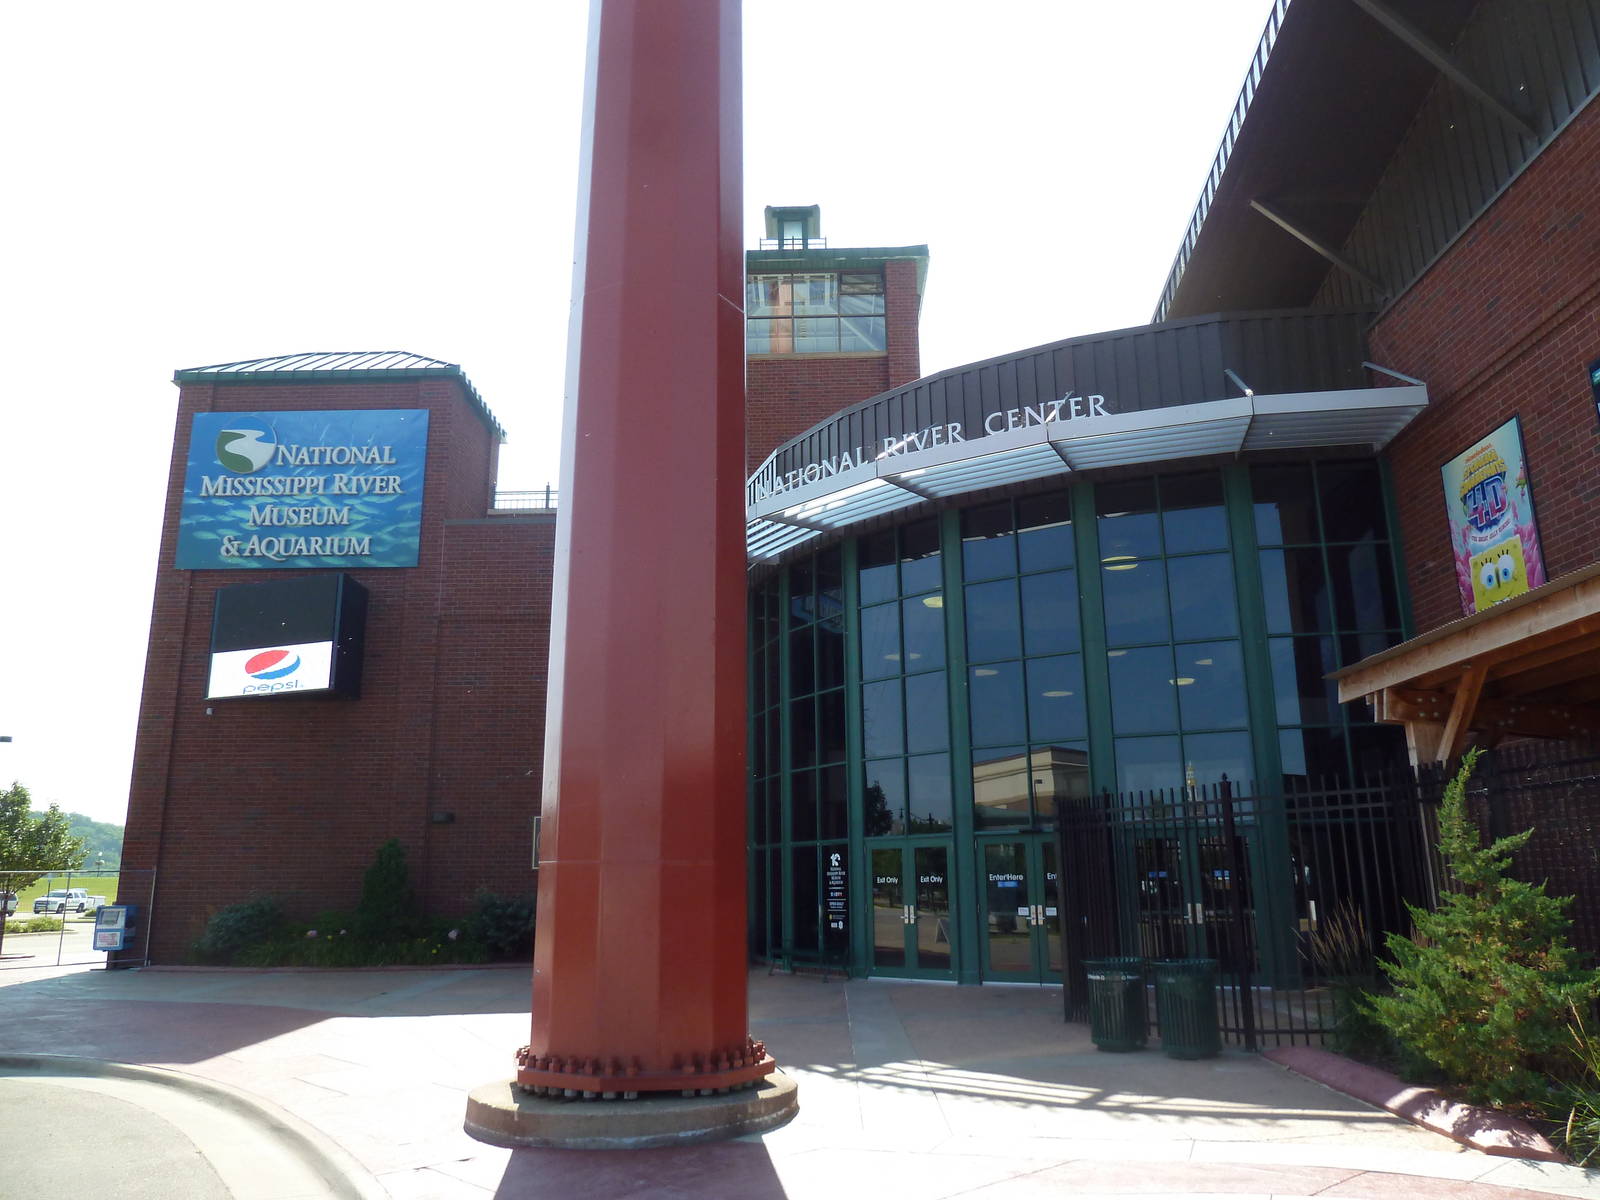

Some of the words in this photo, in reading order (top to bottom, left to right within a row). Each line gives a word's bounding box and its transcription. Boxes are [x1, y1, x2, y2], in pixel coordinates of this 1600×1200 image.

[276, 444, 397, 467] NATIONAL
[756, 447, 868, 500] NATIONAL
[882, 421, 966, 458] RIVER
[984, 394, 1113, 436] CENTER
[200, 475, 326, 497] MISSISSIPPI
[330, 473, 403, 495] RIVER
[248, 504, 350, 526] MUSEUM
[220, 535, 242, 558] &
[241, 534, 372, 562] AQUARIUM
[242, 679, 299, 695] pepsi
[886, 876, 898, 885] Only
[930, 875, 943, 884] Only
